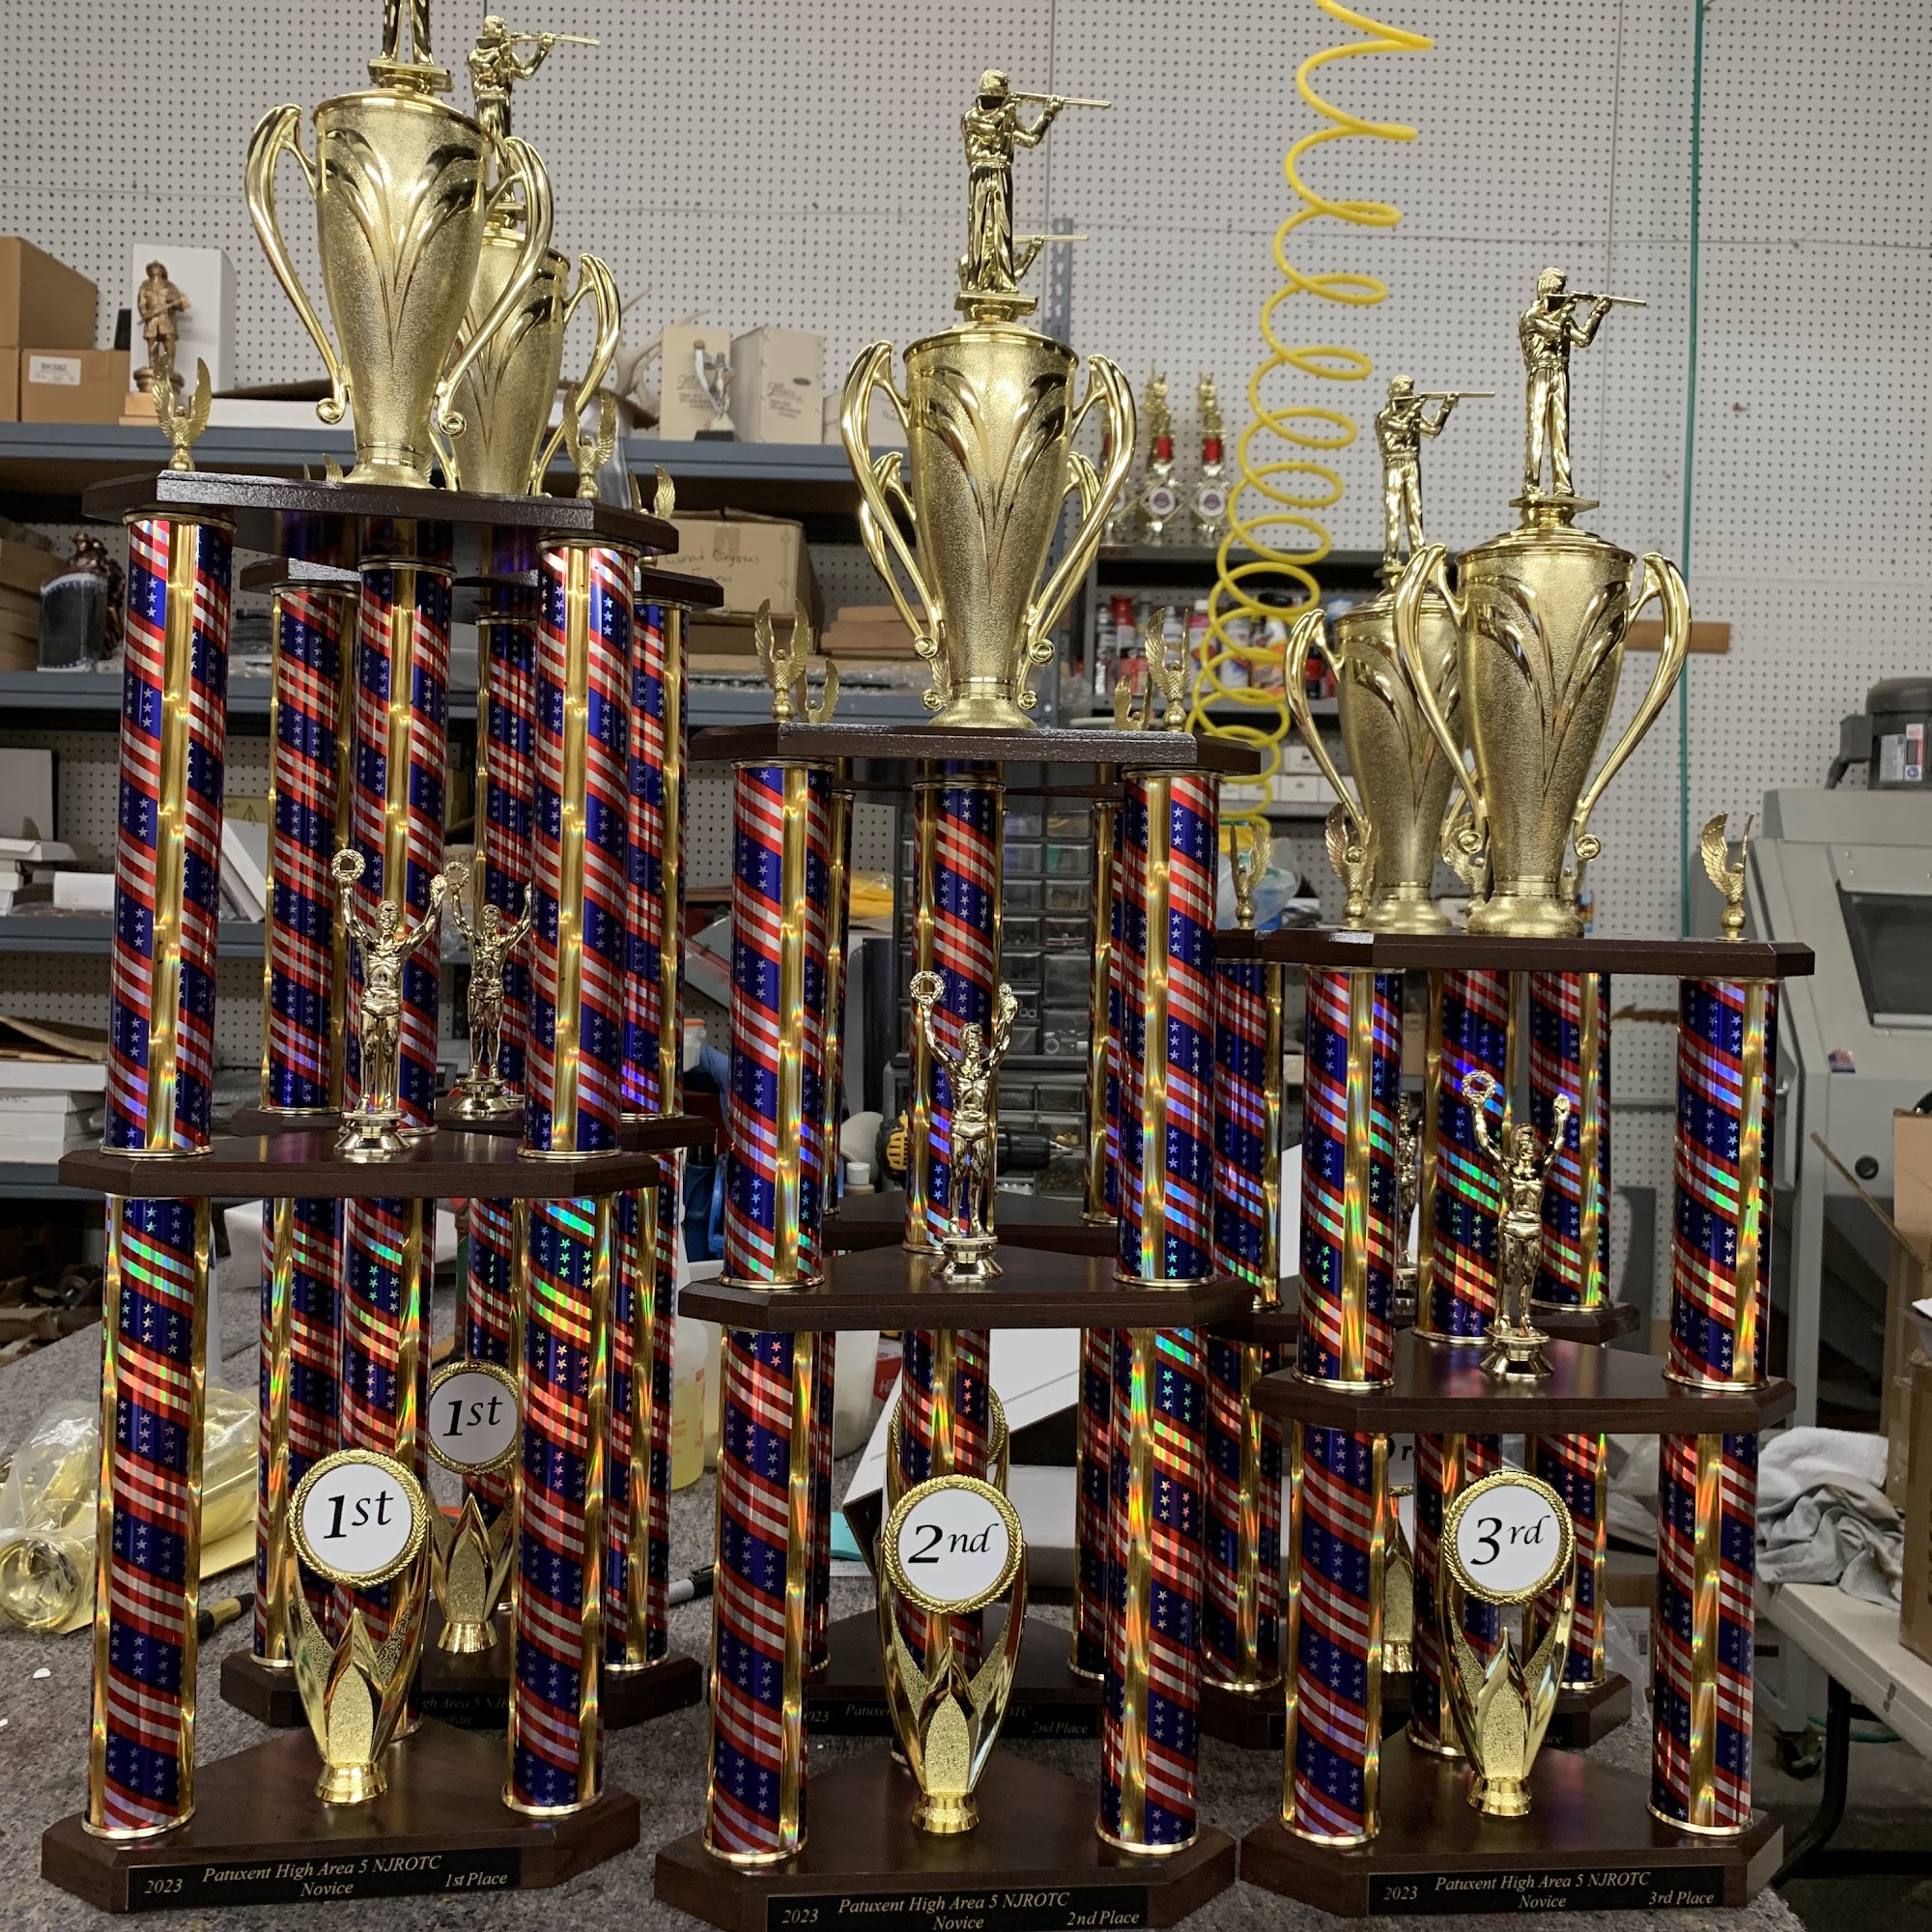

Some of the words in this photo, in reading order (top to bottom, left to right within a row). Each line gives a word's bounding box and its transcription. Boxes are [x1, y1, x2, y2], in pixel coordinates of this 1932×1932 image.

[442, 1396, 503, 1436] 1st
[323, 1491, 394, 1539] 1st
[907, 1522, 999, 1564] 2nd
[1469, 1515, 1550, 1566] 3rd
[845, 1703, 893, 1718] Patuxe
[1031, 1720, 1054, 1734] 2nd
[1055, 1720, 1089, 1735] Place
[201, 1865, 271, 1884] Patuxent
[274, 1861, 314, 1882] High
[317, 1861, 355, 1876] Area
[357, 1859, 368, 1874] 5
[372, 1855, 442, 1873] NJROTC
[145, 1878, 184, 1894] 2023
[445, 1873, 465, 1888] 1st
[466, 1872, 508, 1887] Place
[1435, 1876, 1497, 1891] Patuxent
[1500, 1874, 1534, 1892] High
[1537, 1875, 1572, 1889] Area
[1575, 1873, 1584, 1888] 5
[1587, 1871, 1651, 1888] NJROTC
[299, 1882, 354, 1897] Novice
[1383, 1886, 1418, 1901] 2023
[1648, 1889, 1674, 1906] 3rd
[1676, 1890, 1715, 1905] Place
[838, 1898, 905, 1914] Patuxent
[908, 1895, 946, 1915] High
[949, 1895, 984, 1910] Area
[988, 1893, 999, 1909] 5
[1002, 1891, 1070, 1909] NJROTC
[1518, 1894, 1567, 1909] Novice
[781, 1908, 819, 1924] 2023
[932, 1915, 984, 1931] Novice
[1066, 1911, 1097, 1926] 2nd
[1098, 1910, 1140, 1925] Place
